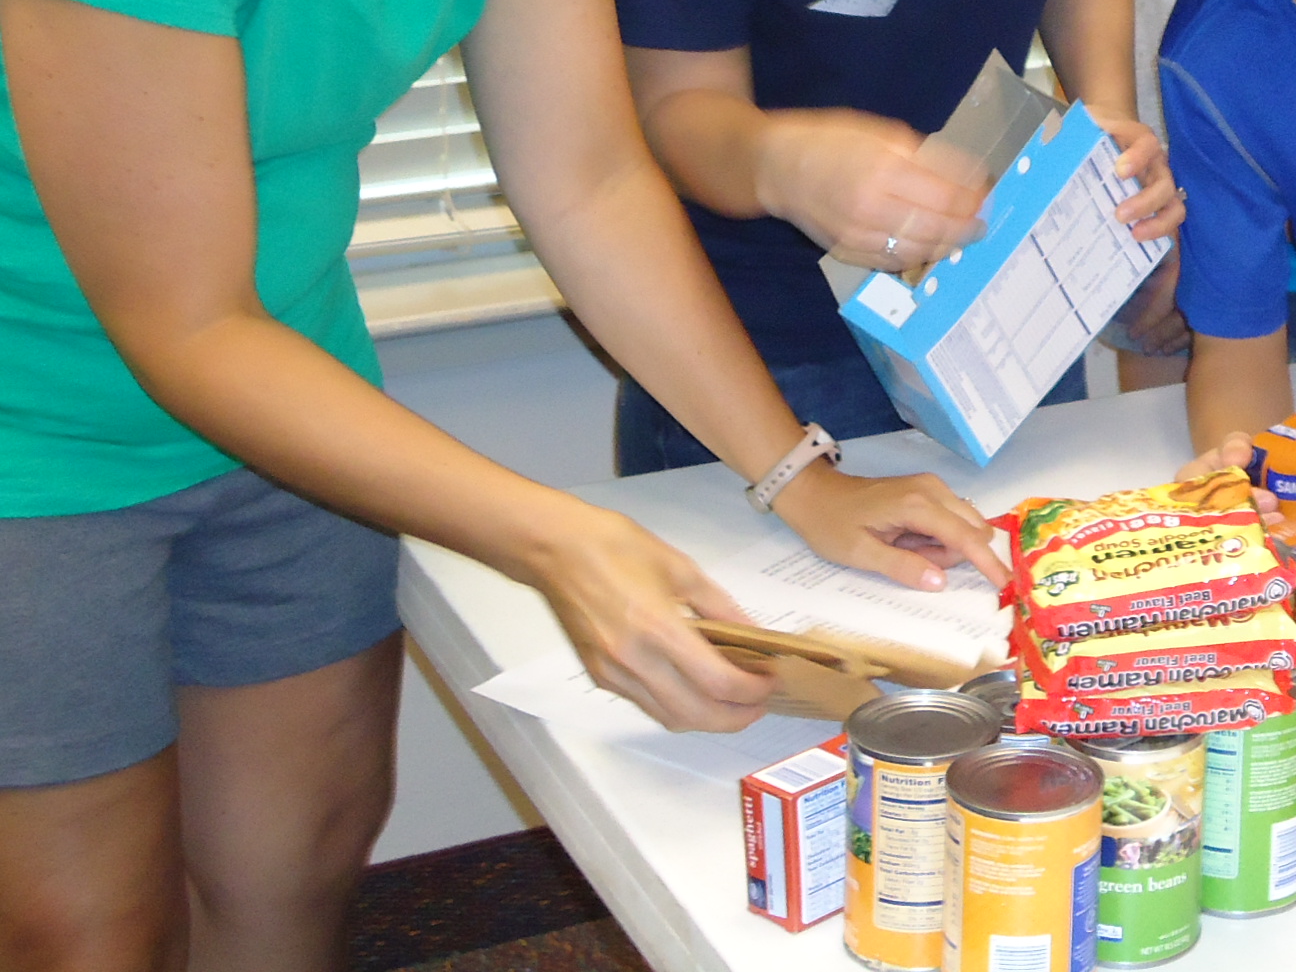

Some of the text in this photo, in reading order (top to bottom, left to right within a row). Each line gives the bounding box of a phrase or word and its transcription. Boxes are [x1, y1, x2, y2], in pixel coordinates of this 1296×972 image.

[1093, 538, 1142, 553] Soup
[1129, 589, 1212, 610] Beef Flavor
[1165, 595, 1268, 622] Maruchan
[1134, 653, 1217, 667] Beef Flavor
[1110, 701, 1193, 716] Beef Flavor
[1146, 709, 1249, 732] Maruchan
[881, 774, 932, 787] Nutrition
[1097, 872, 1188, 894] green beans
